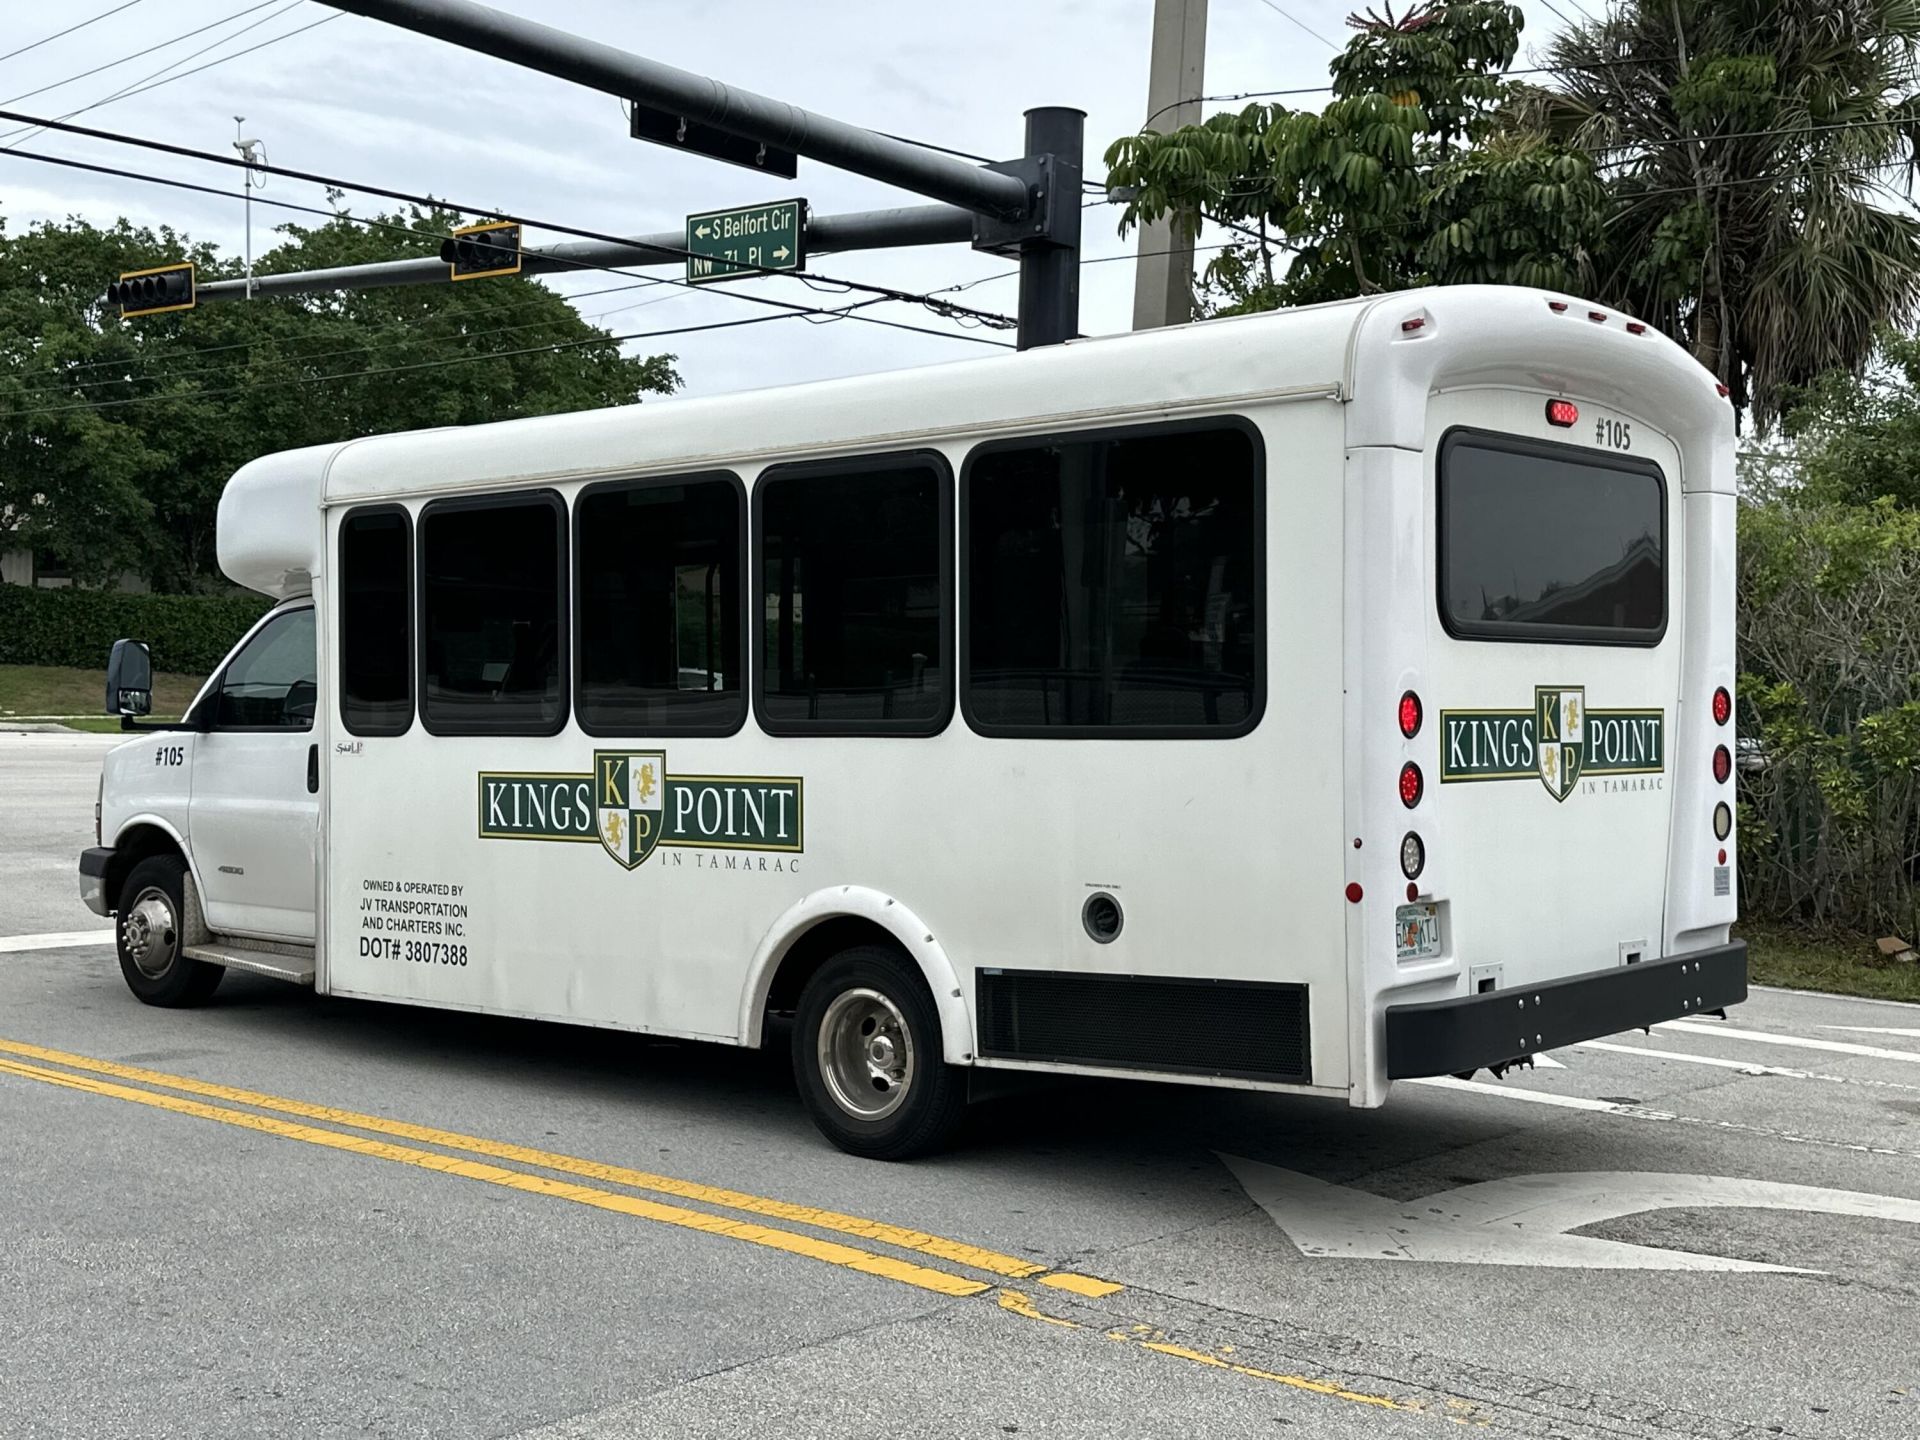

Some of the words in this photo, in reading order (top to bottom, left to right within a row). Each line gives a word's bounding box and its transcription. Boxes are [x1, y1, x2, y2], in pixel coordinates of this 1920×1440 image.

[712, 219, 721, 240] S
[724, 211, 768, 238] Belfort
[771, 208, 792, 231] Cir
[694, 252, 713, 275] NW
[724, 249, 738, 271] 71
[1595, 417, 1631, 451] #105
[1542, 695, 1558, 740] K
[155, 746, 184, 766] #105
[1449, 718, 1534, 768] KINGS
[1589, 719, 1660, 763] POINT
[1563, 746, 1576, 786] P
[602, 759, 625, 806] K
[1582, 781, 1596, 795] IN
[1604, 778, 1664, 793] TAMARAC
[487, 782, 591, 832] KINGS
[673, 786, 794, 839] POINT
[633, 813, 651, 854] P
[662, 851, 682, 866] IN
[695, 853, 800, 874] TAMARAC
[363, 879, 394, 892] OWNED
[395, 881, 402, 893] &
[403, 882, 450, 896] OPERATED
[451, 885, 464, 897] BY
[360, 897, 373, 911] JV
[374, 898, 468, 918] TRANSPORTATION
[362, 916, 384, 930] AND
[386, 918, 442, 935] CHARTERS
[444, 922, 466, 937] INC.
[360, 936, 401, 961] DOT#
[405, 940, 468, 967] 3807388
